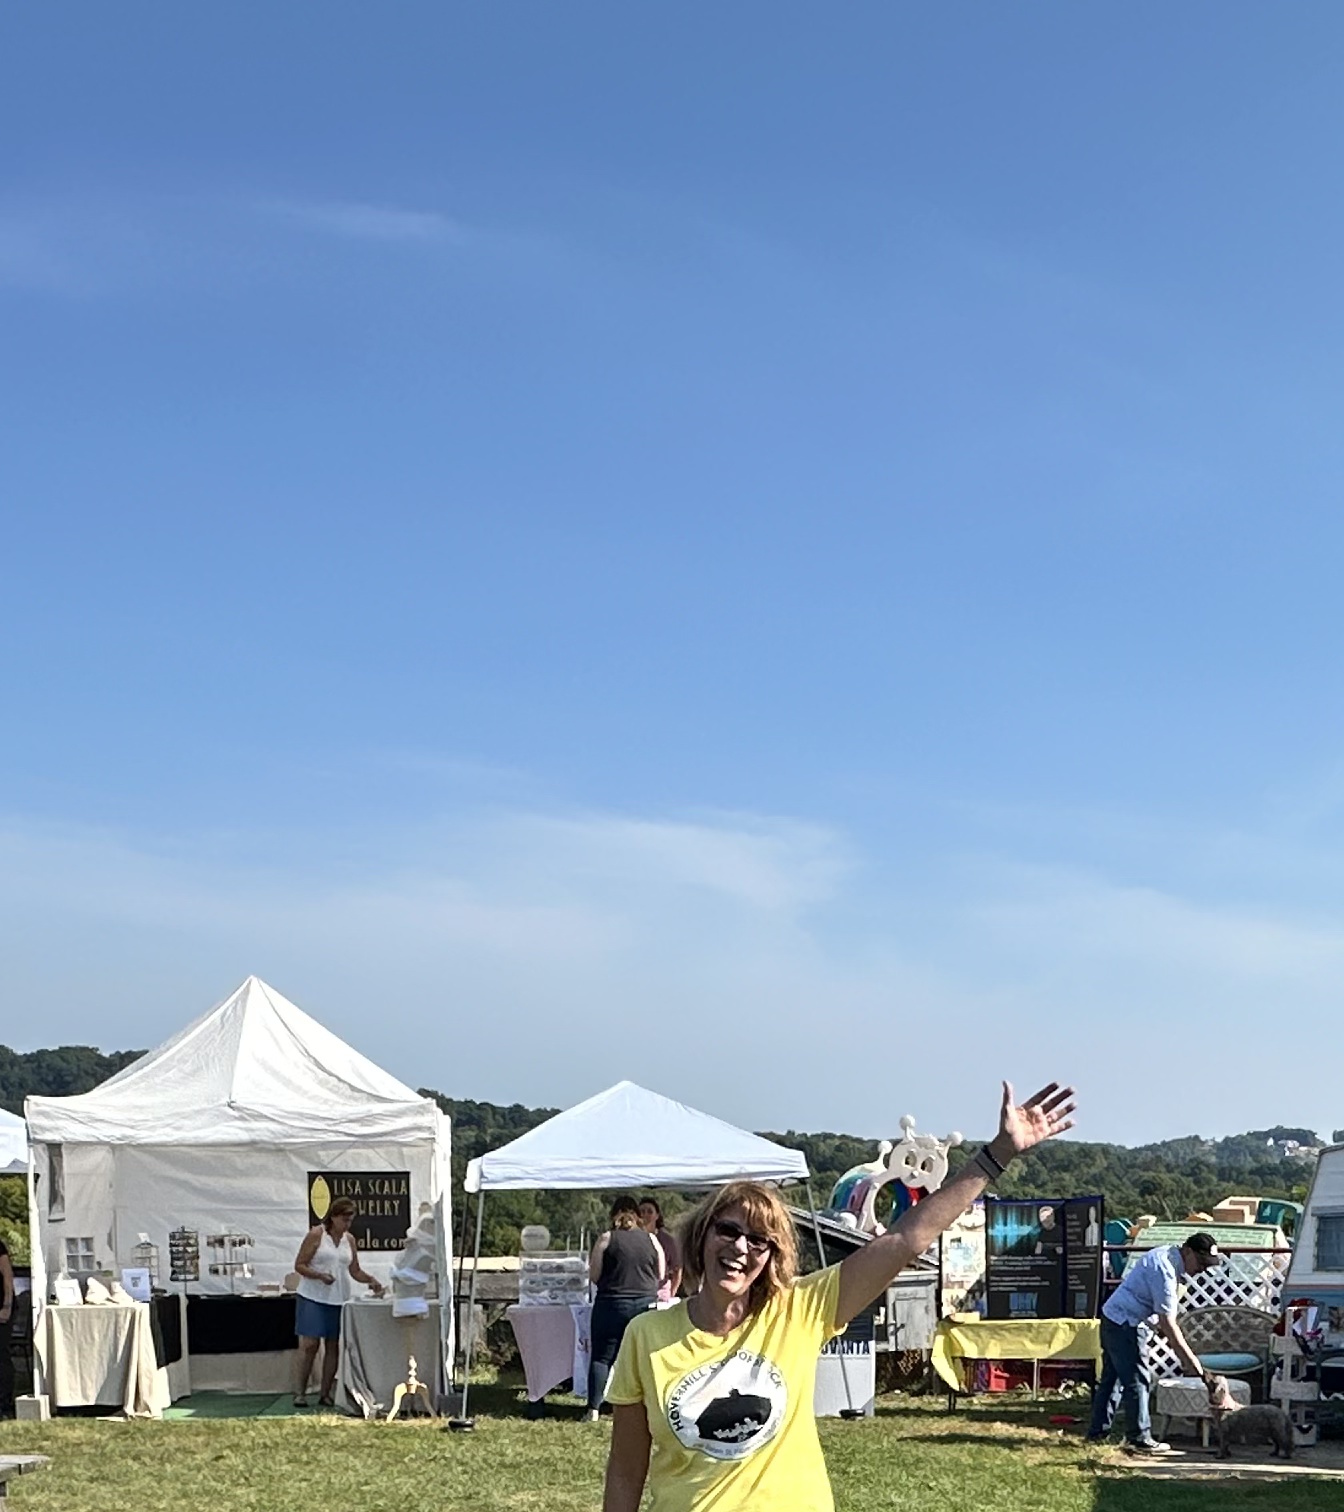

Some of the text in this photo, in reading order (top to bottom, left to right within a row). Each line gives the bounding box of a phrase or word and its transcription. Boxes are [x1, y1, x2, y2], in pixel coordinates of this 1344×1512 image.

[334, 1179, 408, 1195] LISA SCALA
[357, 1200, 400, 1216] WELRY
